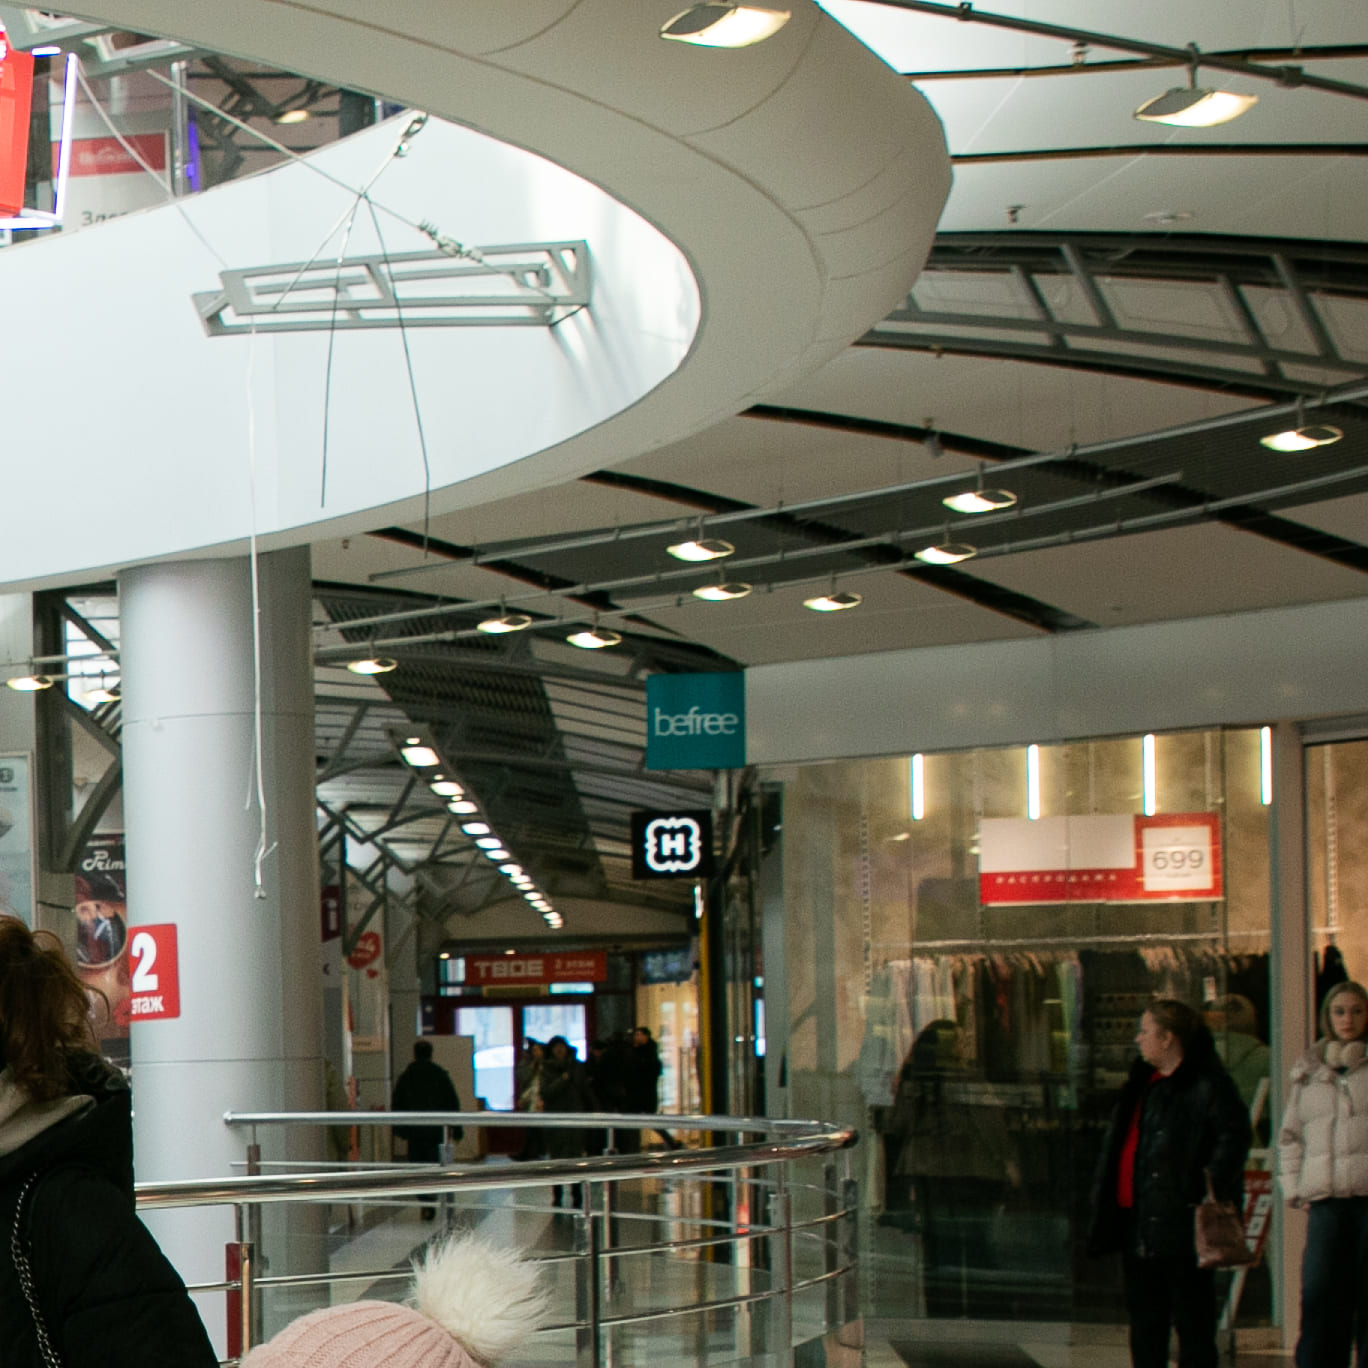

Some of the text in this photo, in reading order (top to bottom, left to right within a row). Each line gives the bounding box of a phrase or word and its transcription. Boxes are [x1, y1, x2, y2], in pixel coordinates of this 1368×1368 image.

[654, 706, 739, 737] befree
[1151, 850, 1205, 871] 699
[131, 932, 159, 993] 2
[473, 958, 544, 978] ТВОЕ
[130, 995, 164, 1015] этаж
